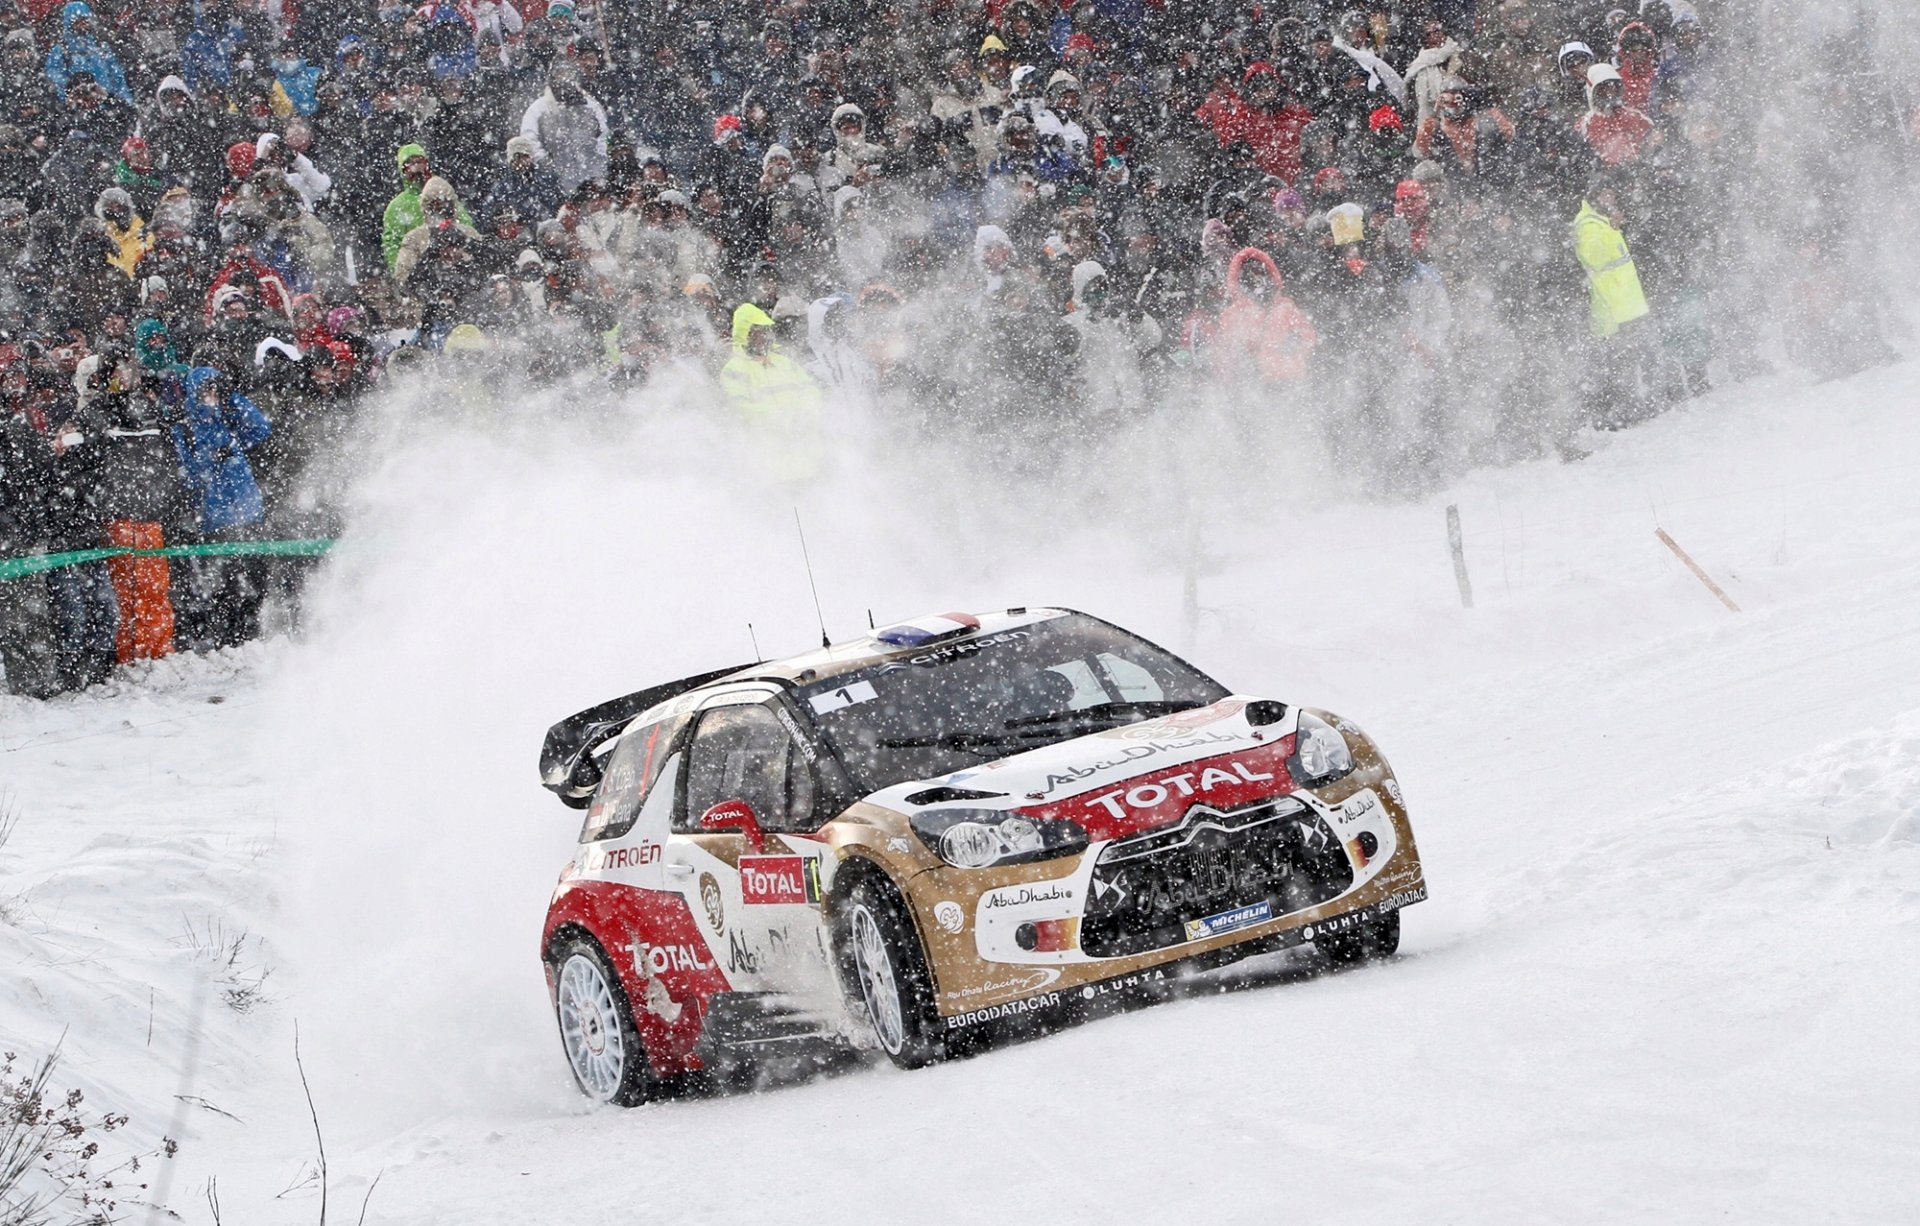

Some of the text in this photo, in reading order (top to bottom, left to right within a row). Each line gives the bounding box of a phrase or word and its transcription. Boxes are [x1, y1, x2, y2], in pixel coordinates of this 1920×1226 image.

[835, 688, 854, 704] 1
[1084, 761, 1274, 819] TOTAL
[708, 808, 744, 822] TOTAL
[742, 867, 802, 895] TOTAL
[810, 859, 820, 901] 1
[1212, 905, 1268, 928] MICHELIN
[1318, 911, 1369, 934] LUHTA
[625, 942, 707, 979] TOTAL
[1099, 970, 1165, 994] LUHTA
[947, 993, 1061, 1029] EURODATACAR
